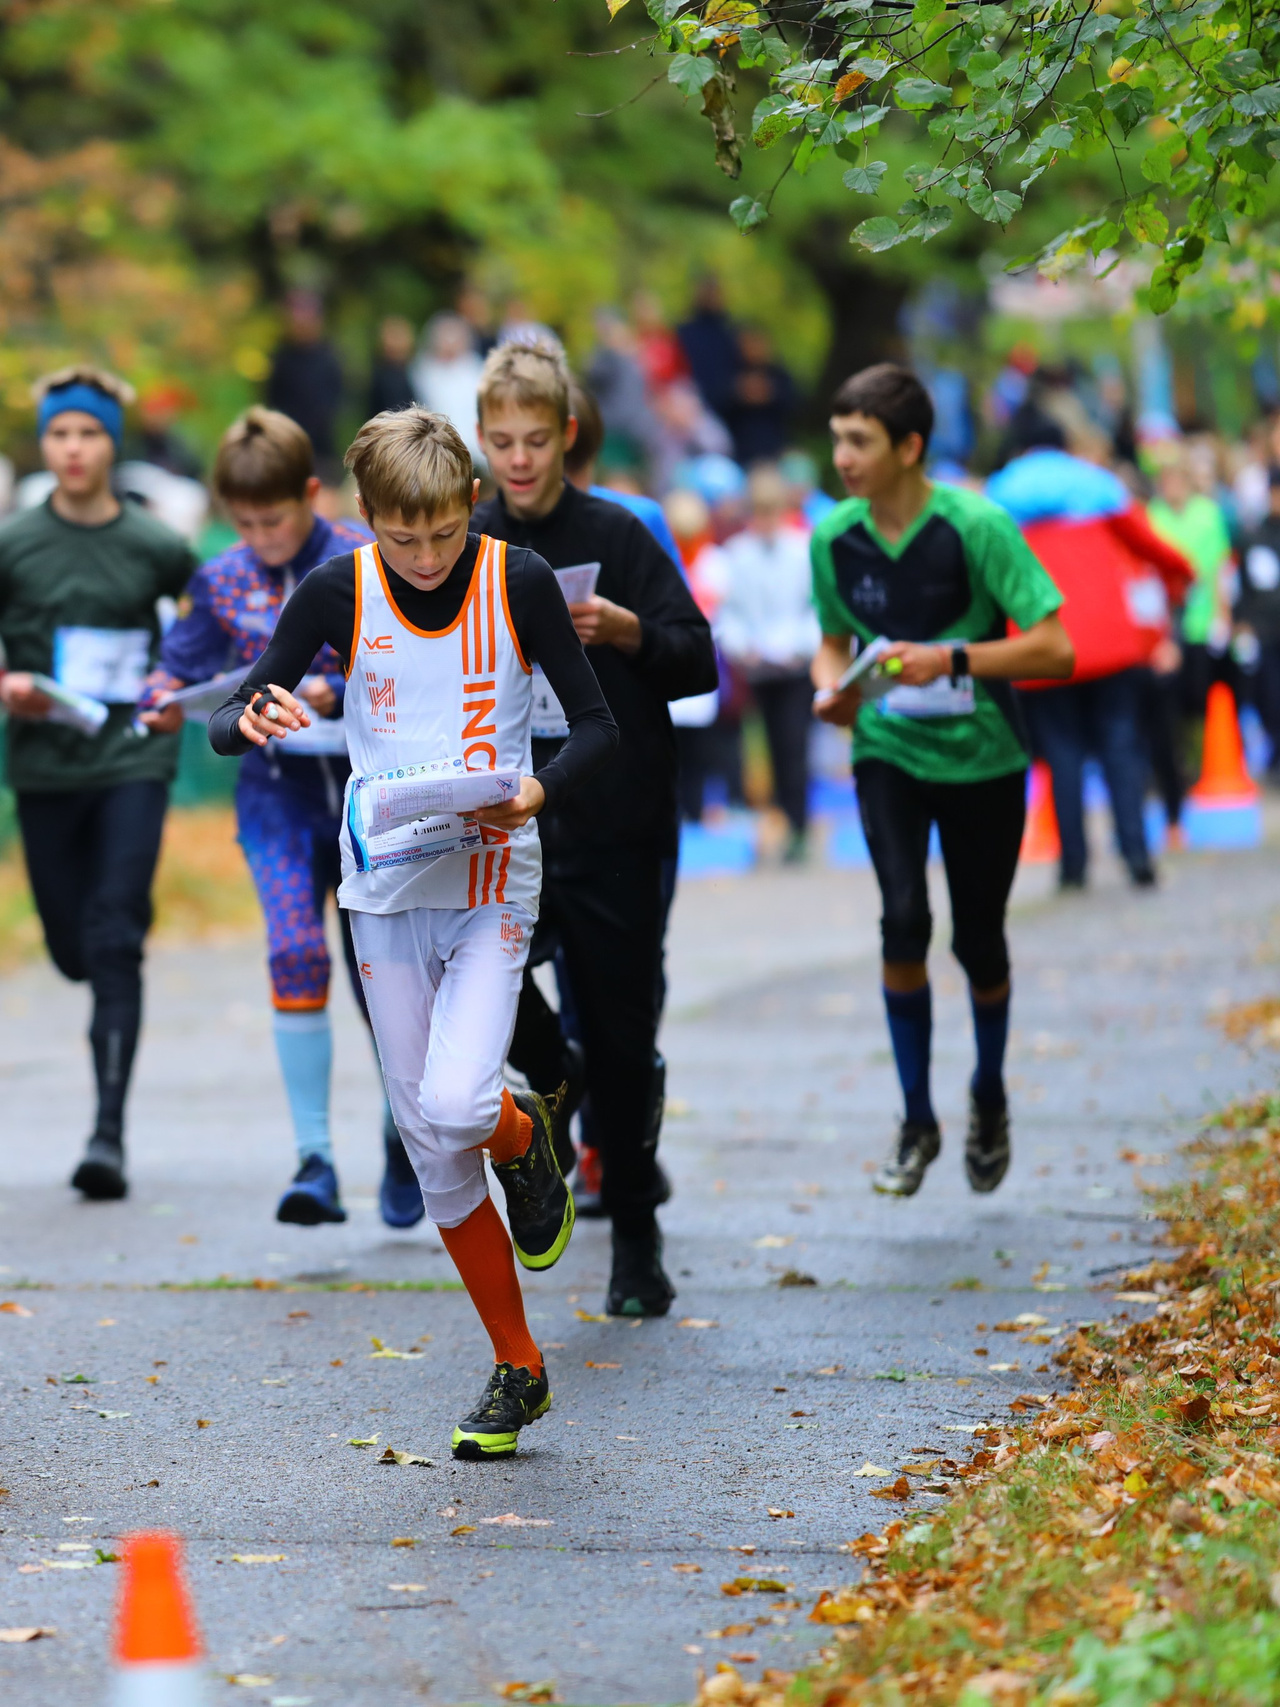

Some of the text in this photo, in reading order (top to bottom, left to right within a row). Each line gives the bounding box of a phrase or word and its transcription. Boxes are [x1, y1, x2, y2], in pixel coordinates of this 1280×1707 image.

[363, 636, 393, 650] VC
[412, 823, 451, 836] 4 линия
[401, 848, 422, 856] РОССИИ
[412, 846, 455, 860] СОРЕВНОВАНИЯ
